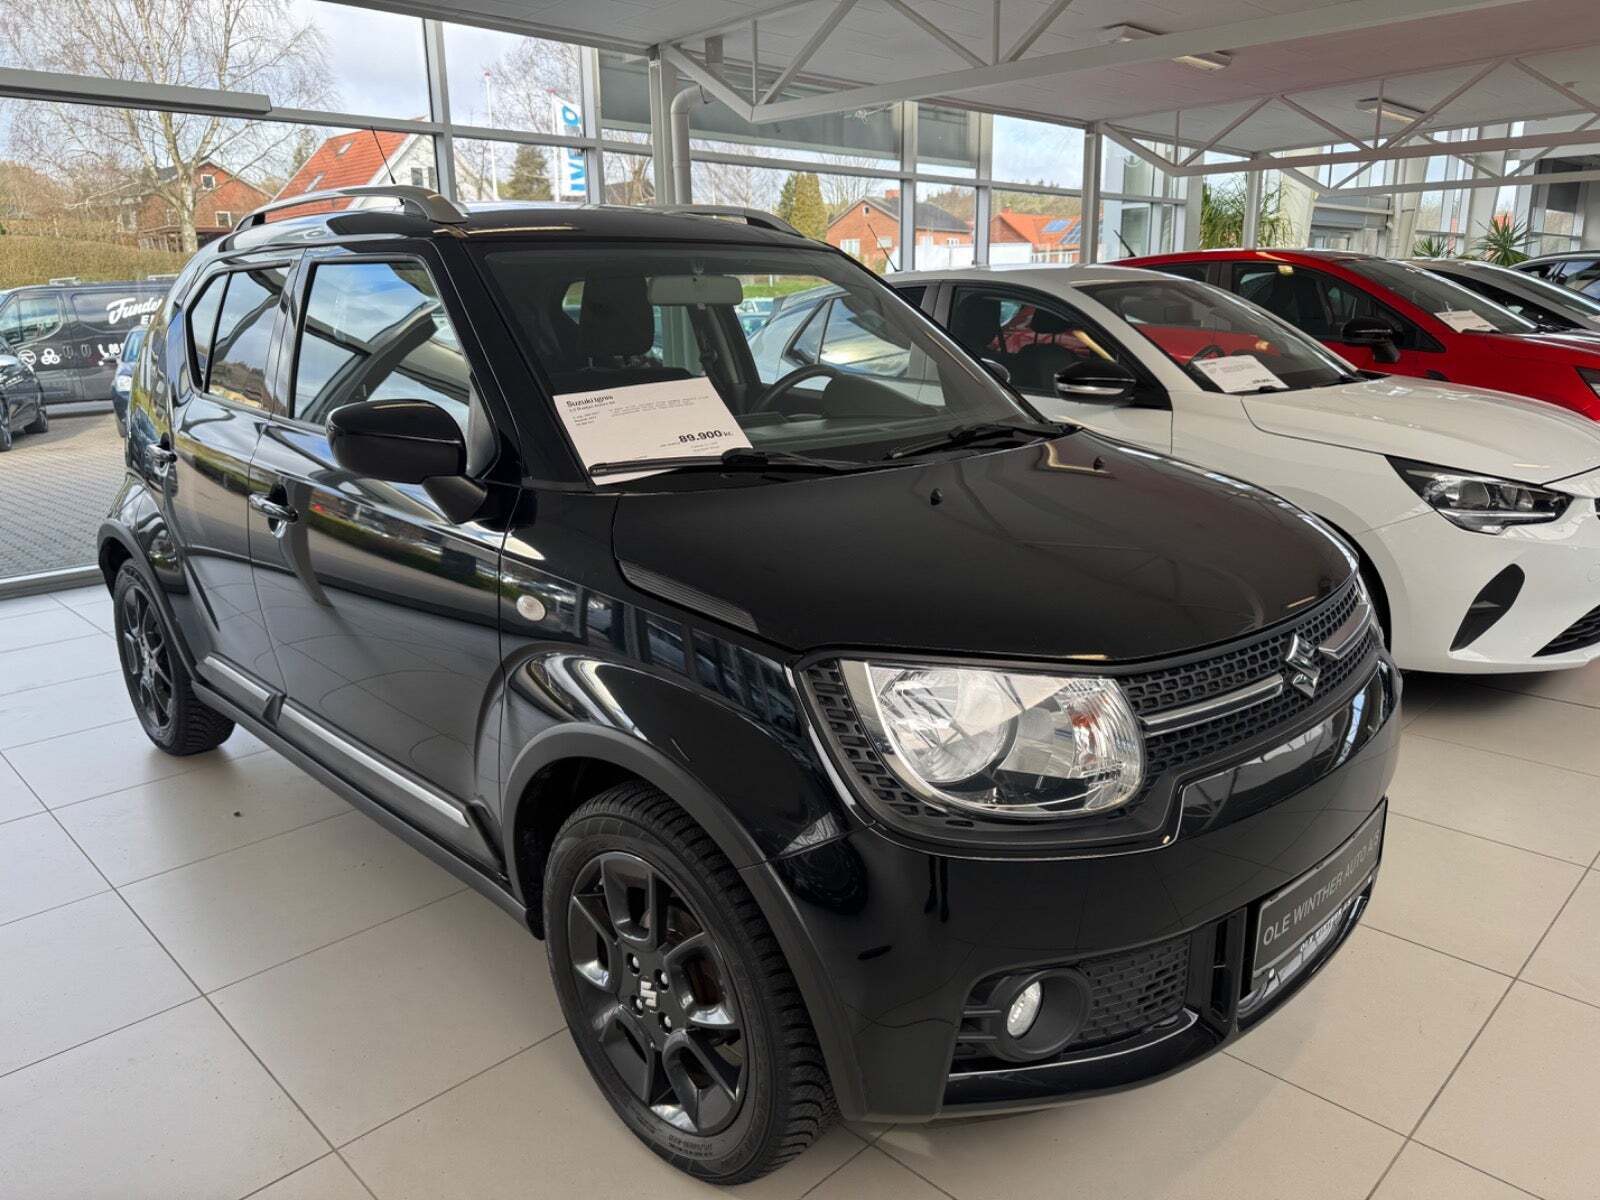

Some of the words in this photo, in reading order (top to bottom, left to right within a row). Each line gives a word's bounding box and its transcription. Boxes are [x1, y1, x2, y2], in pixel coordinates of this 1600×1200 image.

[561, 106, 586, 191] IVEO
[566, 397, 594, 408] Suzuki
[679, 430, 723, 444] 89.900
[1263, 913, 1291, 946] OLE
[1293, 872, 1343, 924] WINTHER
[1345, 845, 1368, 878] AUTO
